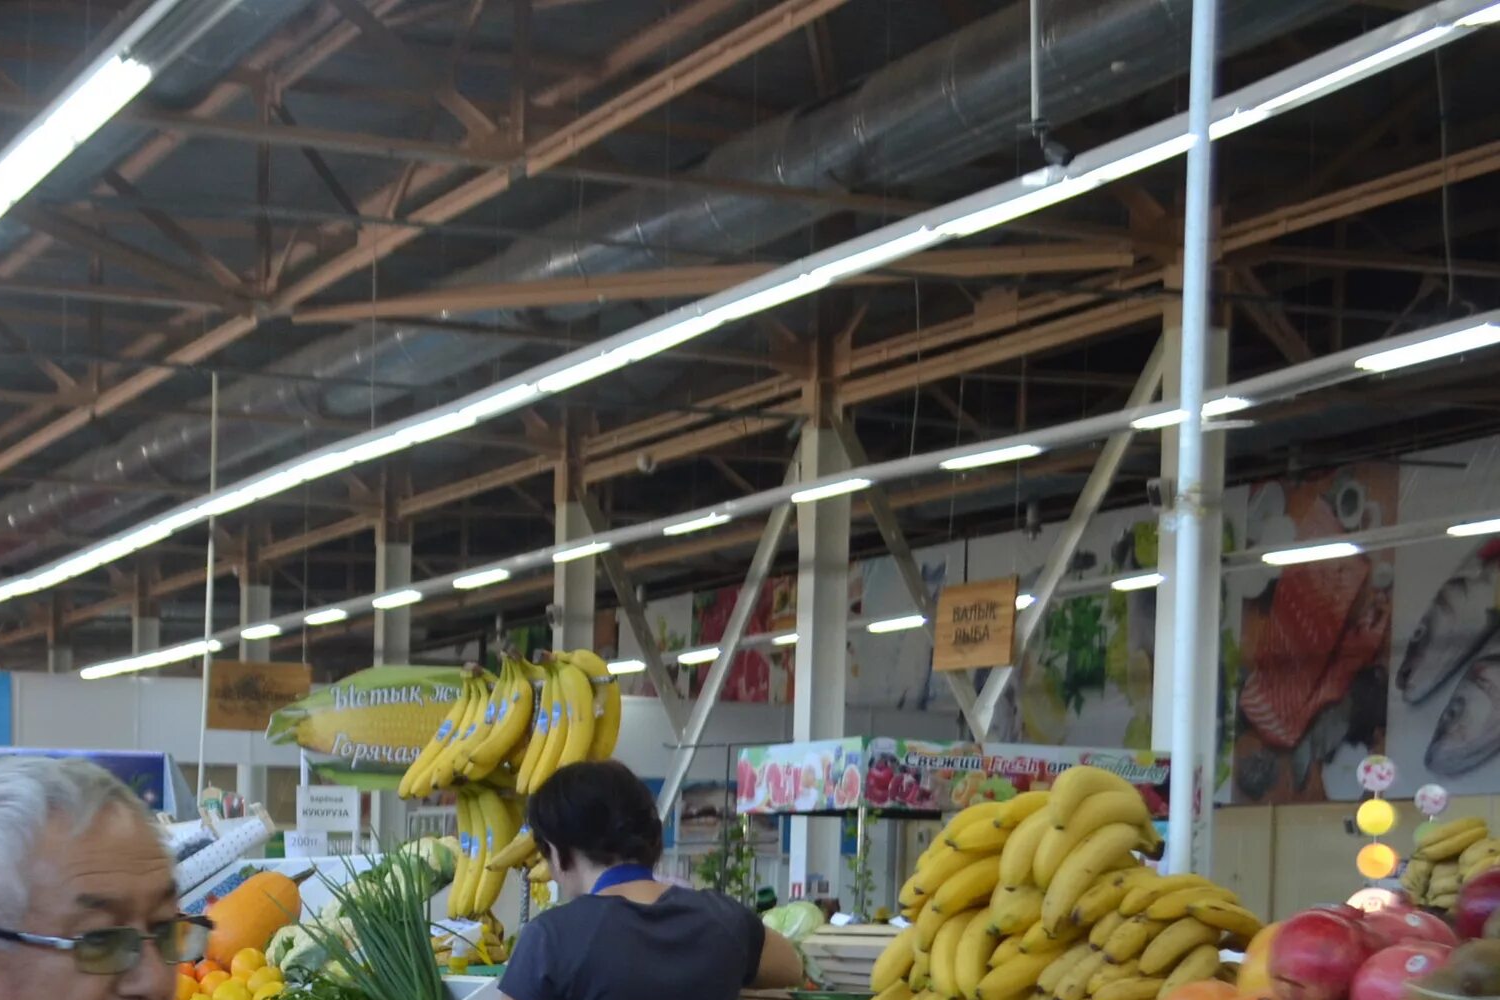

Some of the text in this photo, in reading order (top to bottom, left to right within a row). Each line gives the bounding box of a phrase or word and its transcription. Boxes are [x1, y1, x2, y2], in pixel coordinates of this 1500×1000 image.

[332, 733, 421, 769] Горячая
[904, 751, 981, 770] Свежий
[988, 755, 1040, 774] Fresh
[302, 808, 349, 818] КУКУРУЗА
